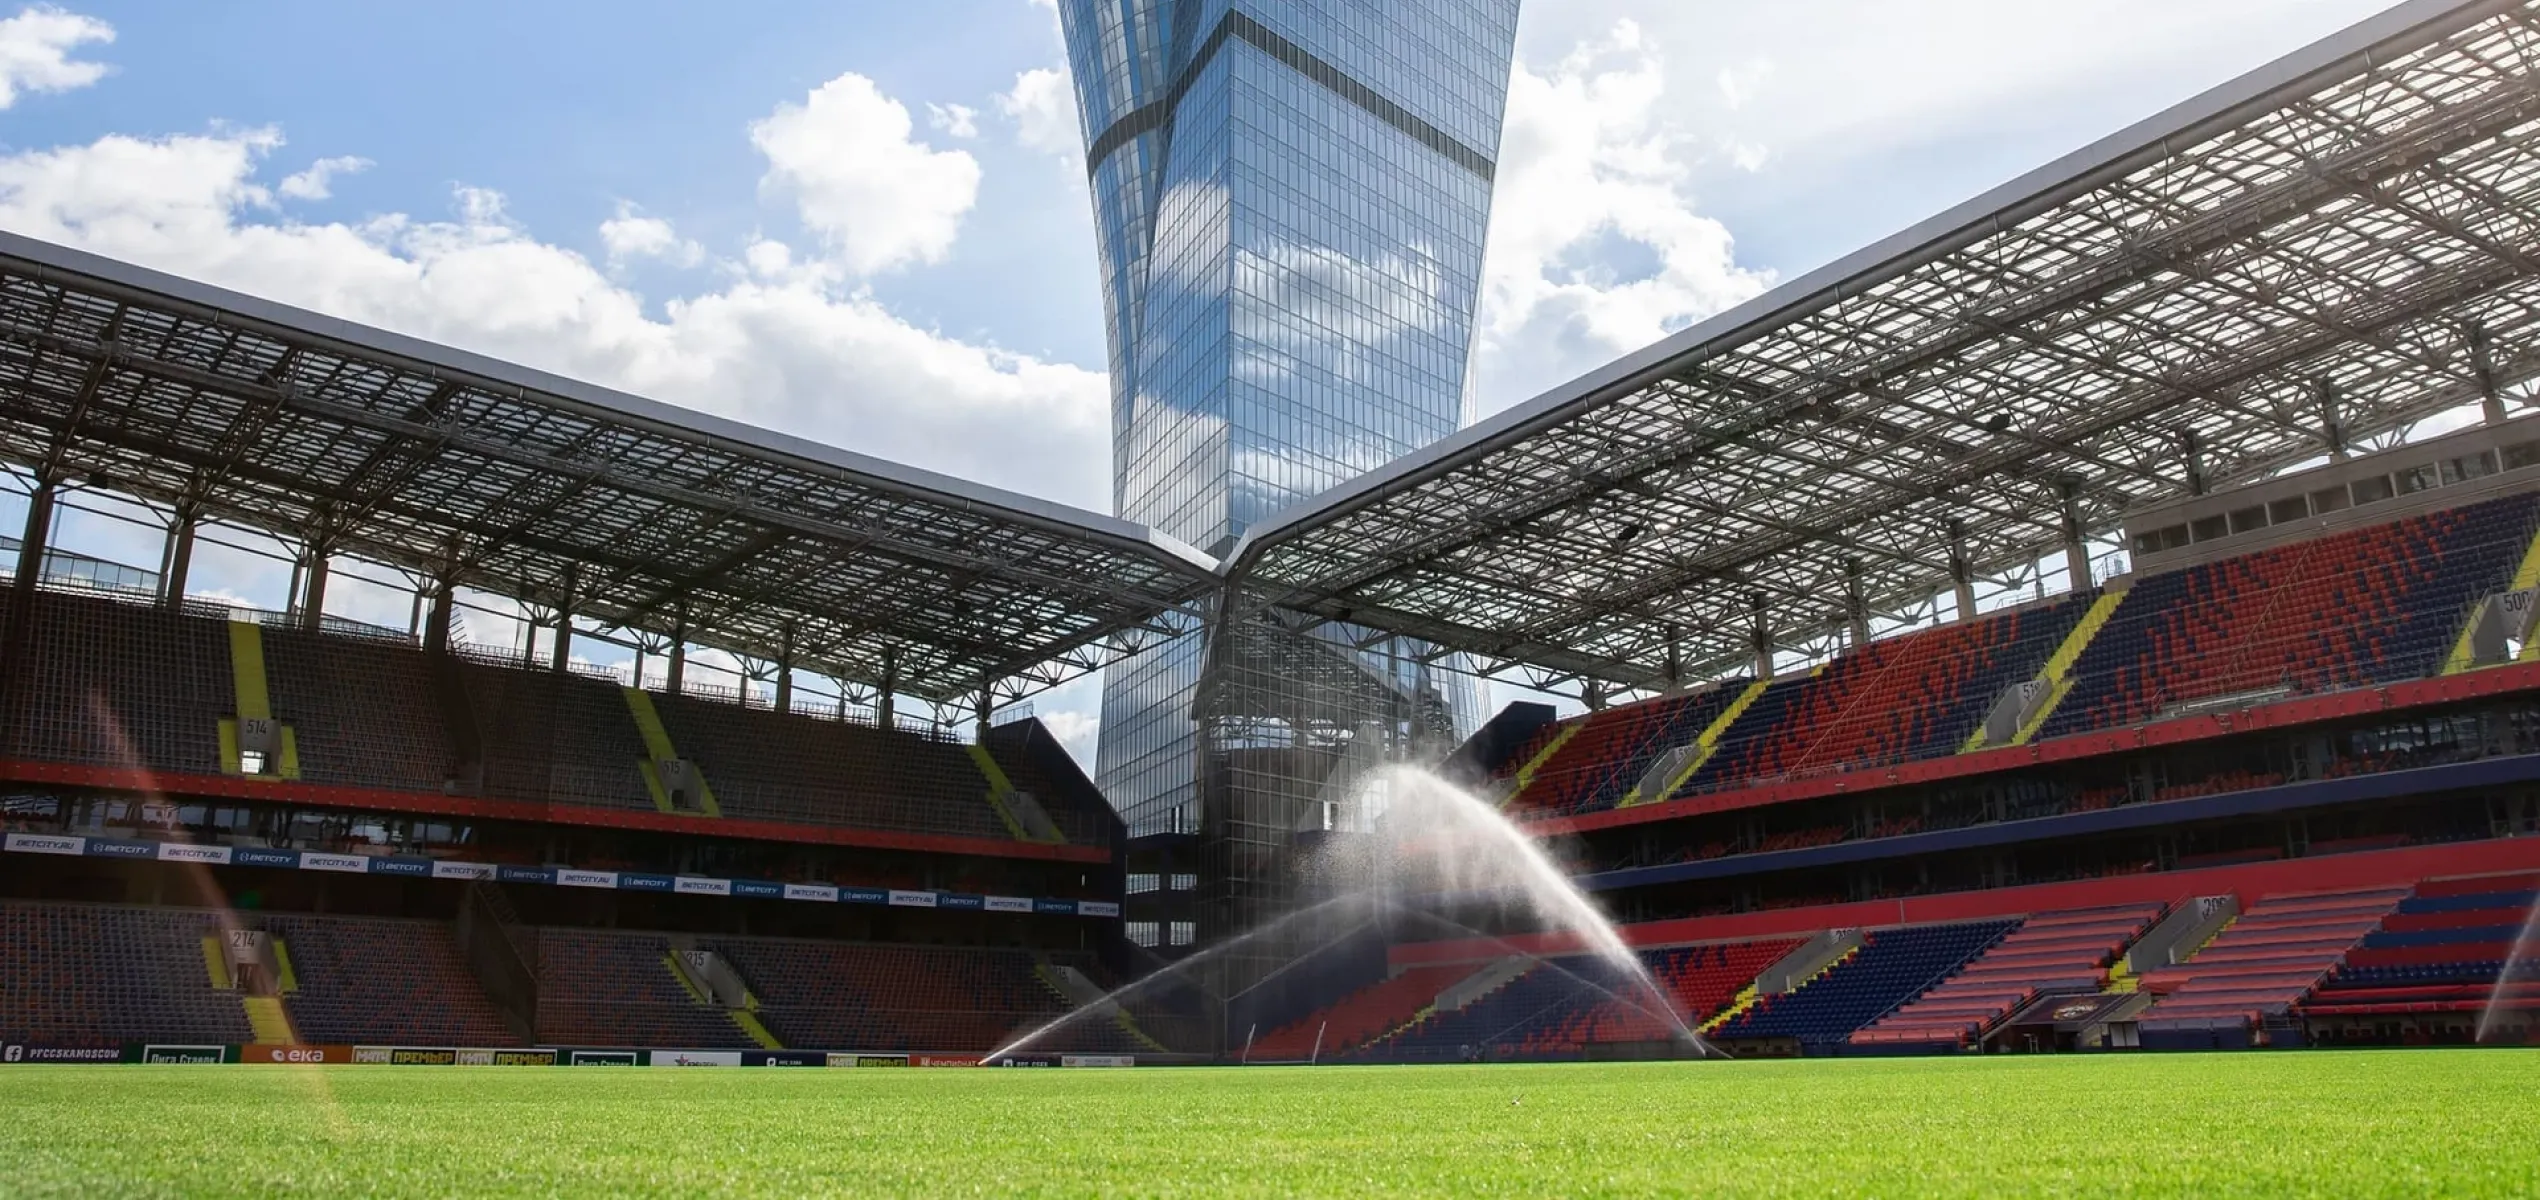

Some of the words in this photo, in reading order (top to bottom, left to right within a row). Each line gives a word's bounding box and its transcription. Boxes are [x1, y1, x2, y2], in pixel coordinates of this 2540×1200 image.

[246, 720, 267, 735] 514
[15, 839, 75, 850] BETCITY.RU
[104, 844, 149, 854] BETCITY
[168, 848, 223, 859] BETCITY.RU
[249, 854, 292, 863] BETCITY
[309, 859, 360, 868] BETCITY.RU
[385, 863, 426, 872] BETCITY
[565, 874, 611, 883] BETCITY.RU
[232, 932, 255, 948] 214
[29, 1048, 119, 1058] PFCCSKAMOSCOW
[356, 1051, 389, 1063] МАТЧ
[394, 1051, 454, 1063] ПРЕМЬЕР
[496, 1053, 553, 1066] ПРЕМЬЕР
